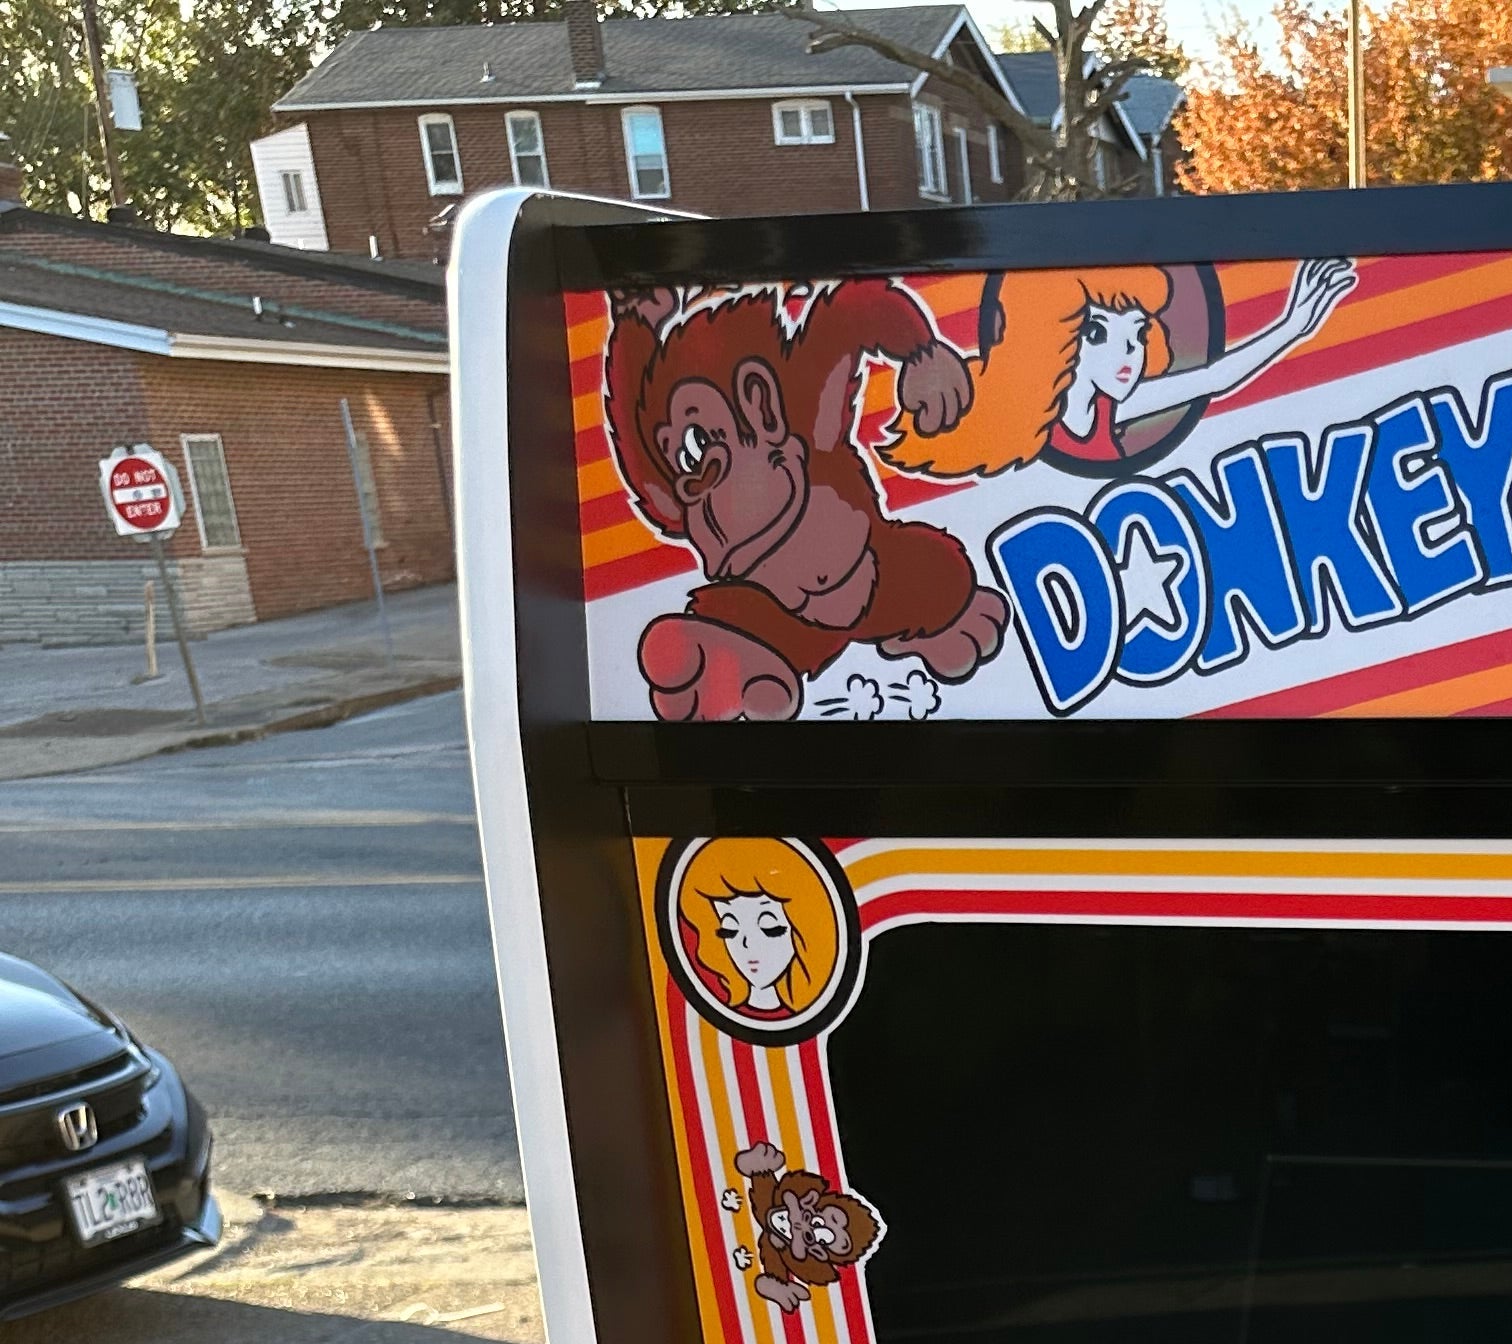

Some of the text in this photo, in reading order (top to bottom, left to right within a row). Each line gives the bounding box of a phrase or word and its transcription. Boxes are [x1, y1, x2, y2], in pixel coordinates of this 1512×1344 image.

[113, 468, 157, 487] DO NOT
[126, 501, 163, 519] ENTER
